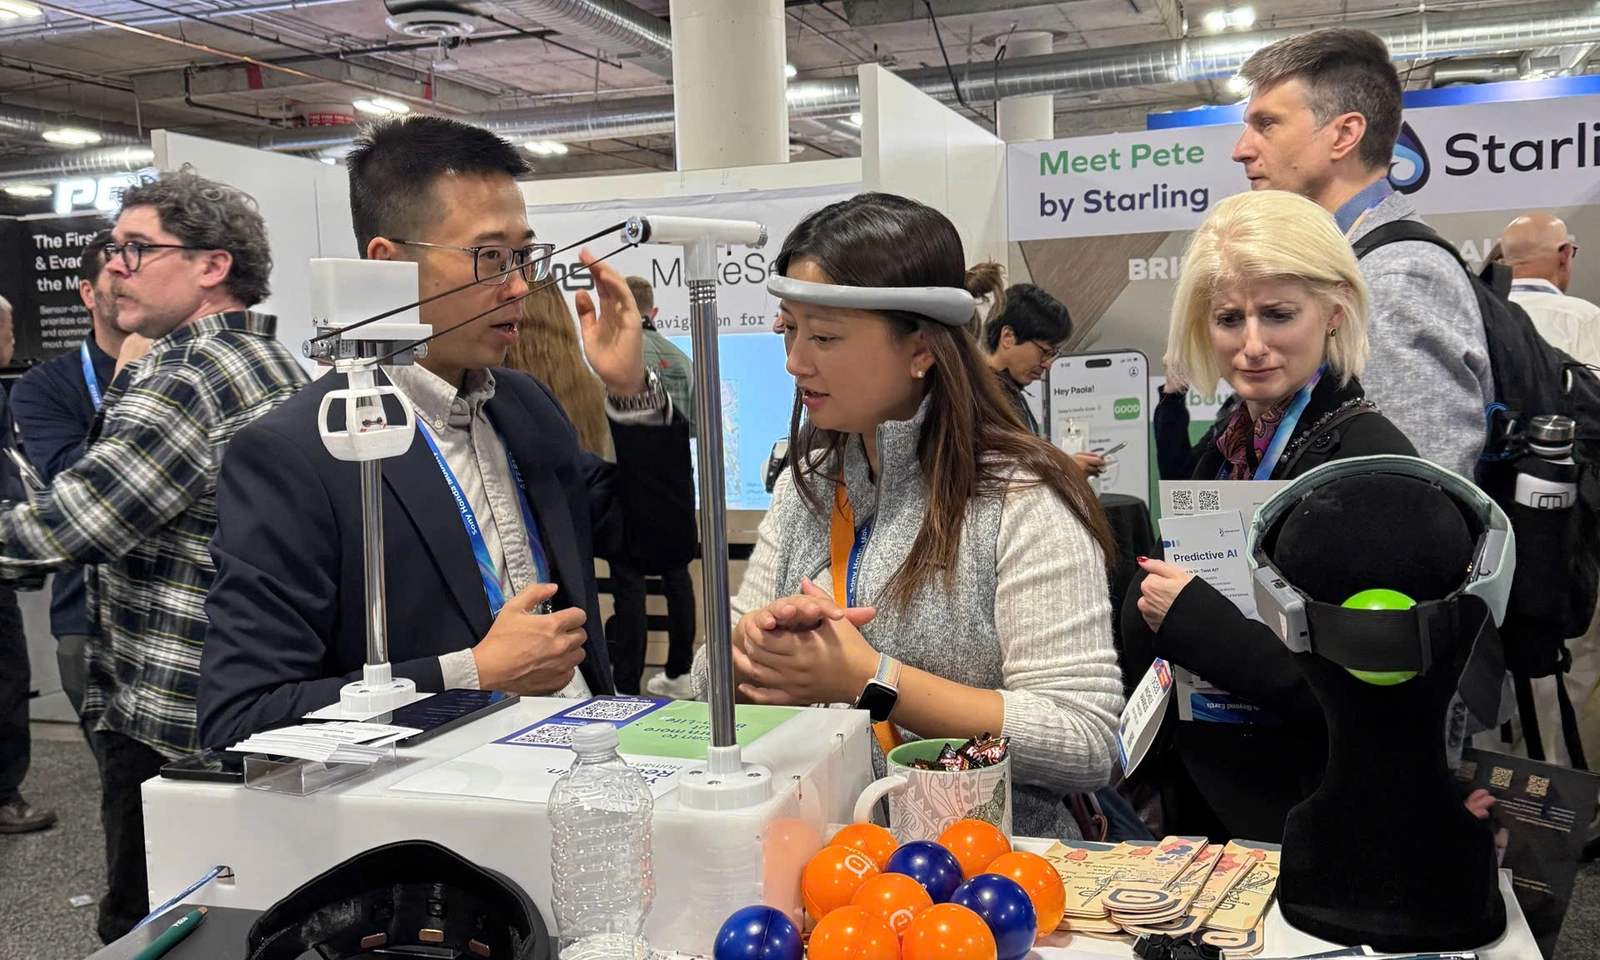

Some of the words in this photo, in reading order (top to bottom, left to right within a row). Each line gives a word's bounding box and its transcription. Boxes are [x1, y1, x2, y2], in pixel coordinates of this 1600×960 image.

[1445, 122, 1600, 176] Starli
[1040, 149, 1121, 176] Meet
[1131, 143, 1205, 169] Pete
[1040, 192, 1075, 222] by
[1083, 183, 1209, 214] Starling
[32, 234, 64, 249] The
[35, 256, 46, 271] &
[49, 255, 82, 270] Evac
[1128, 256, 1181, 281] BRI
[37, 278, 63, 292] the
[740, 312, 765, 326] for
[1054, 387, 1070, 397] Hey
[1070, 384, 1095, 395] Paola!
[1114, 404, 1140, 414] GOOD
[450, 485, 468, 514] Honda
[465, 514, 478, 535] Sony
[1173, 550, 1225, 563] Predictive
[1227, 548, 1238, 559] AI
[1206, 702, 1226, 710] Earth
[635, 762, 683, 771] Human
